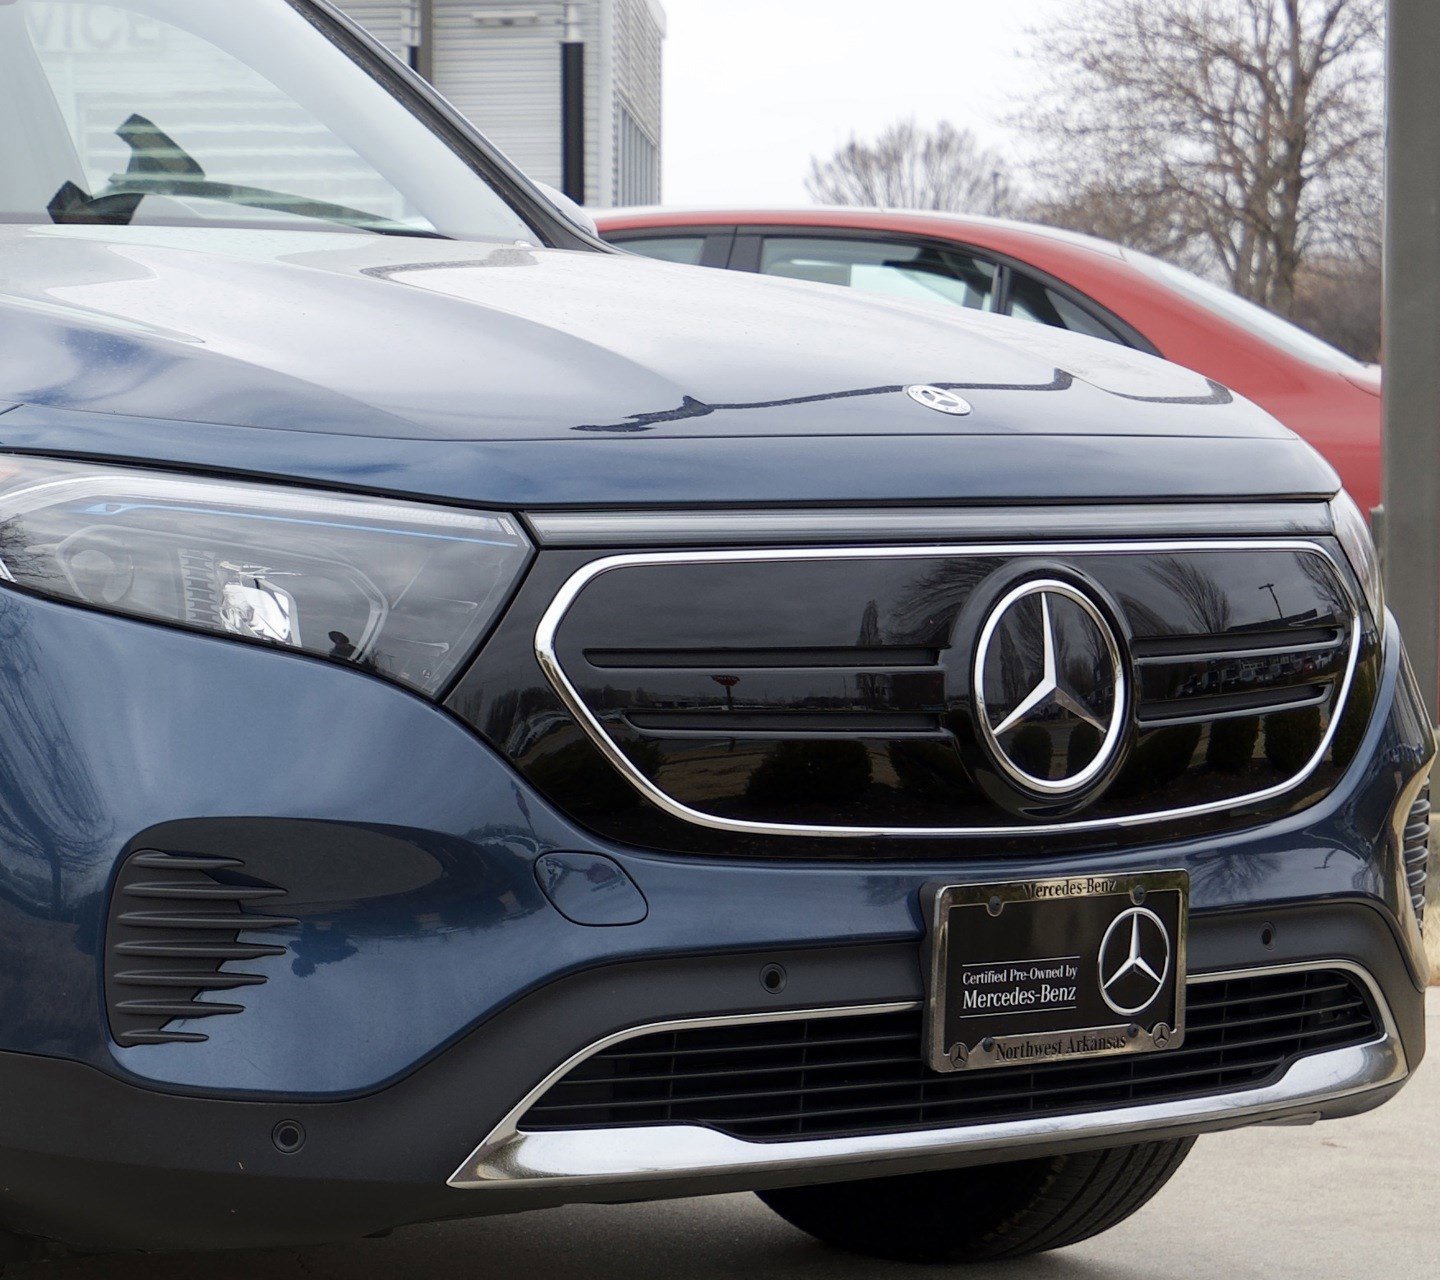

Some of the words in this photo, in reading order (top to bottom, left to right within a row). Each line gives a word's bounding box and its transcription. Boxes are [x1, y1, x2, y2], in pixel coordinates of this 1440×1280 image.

[1022, 878, 1117, 900] Mercedes-Benz
[961, 968, 1008, 986] Certified
[1009, 965, 1064, 982] Pre-Owned
[1065, 963, 1078, 981] by
[962, 984, 1077, 1010] Mercedes-Benz
[995, 1036, 1063, 1062] Northwest
[1065, 1033, 1127, 1055] Arkansas
